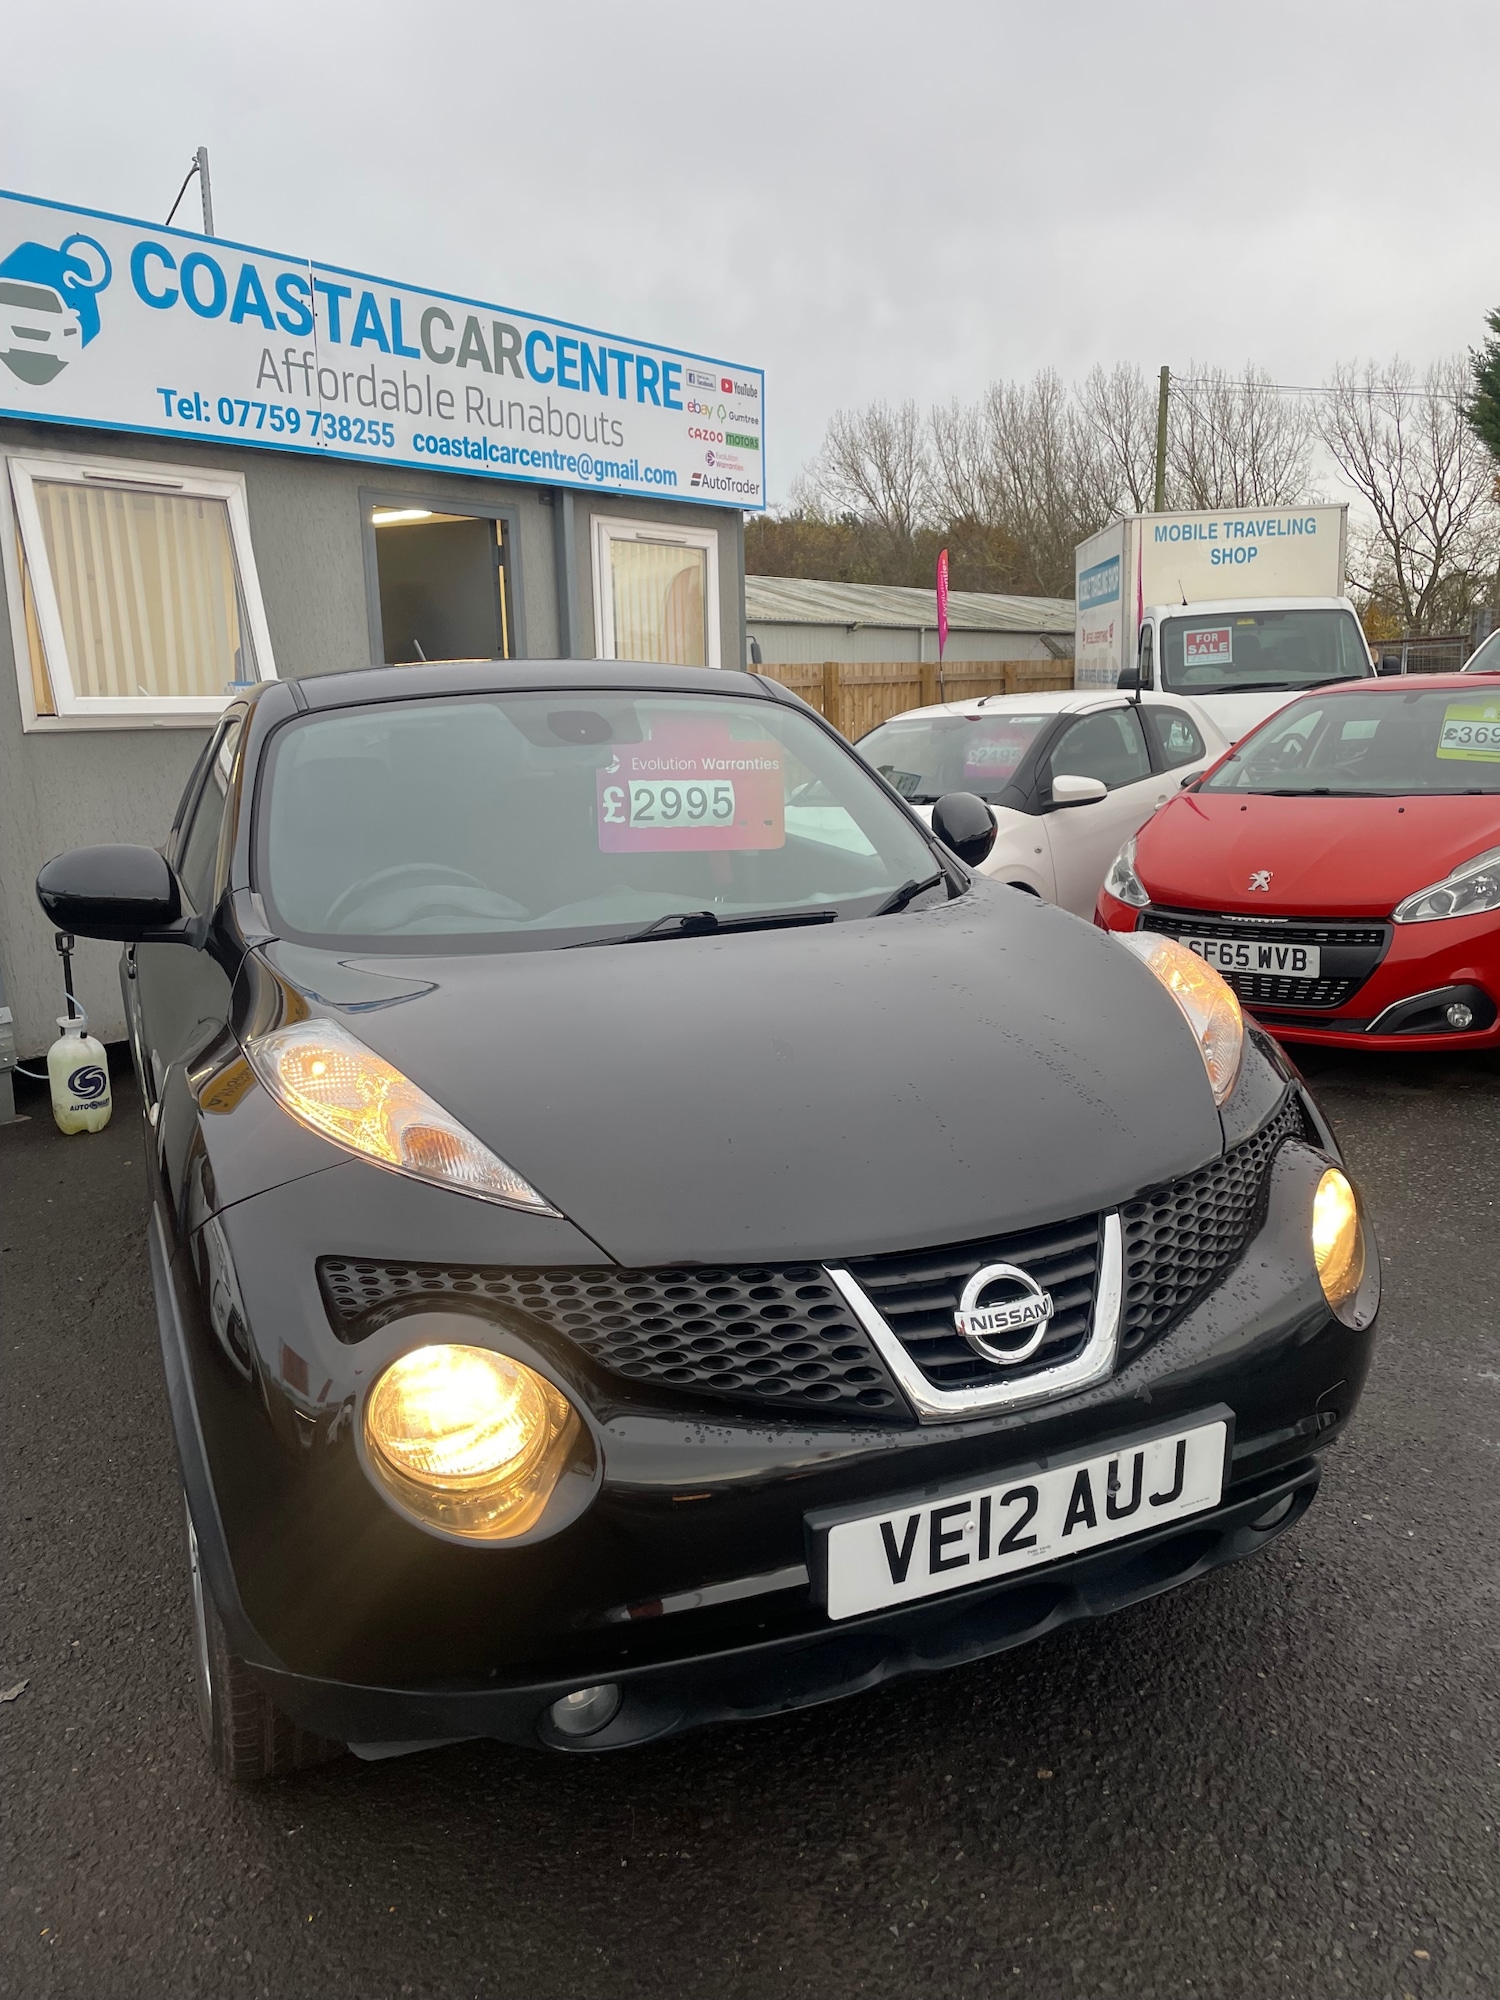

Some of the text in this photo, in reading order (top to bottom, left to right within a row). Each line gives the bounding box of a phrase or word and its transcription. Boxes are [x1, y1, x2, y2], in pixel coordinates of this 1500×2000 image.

[256, 347, 625, 448] Affordable Runabouts
[733, 381, 758, 398] YouTube
[687, 398, 713, 420] ebay
[729, 411, 759, 425] Gumtree
[156, 387, 678, 488] Tel: 07759 738255 coastalcarcentre@gmail.com
[688, 426, 723, 444] CAZOO
[715, 460, 744, 472] Warranties
[701, 473, 760, 495] AutoTrader
[1154, 517, 1317, 543] MOBILE TRAVELING
[1210, 546, 1259, 566] SHOP
[1188, 641, 1228, 655] SALE
[1196, 633, 1219, 644] FOR
[631, 757, 780, 771] Evolution Warranties
[1258, 945, 1307, 972] WVB
[969, 1301, 1049, 1332] NISSAN
[879, 1439, 1187, 1586] VE12 AUJ
